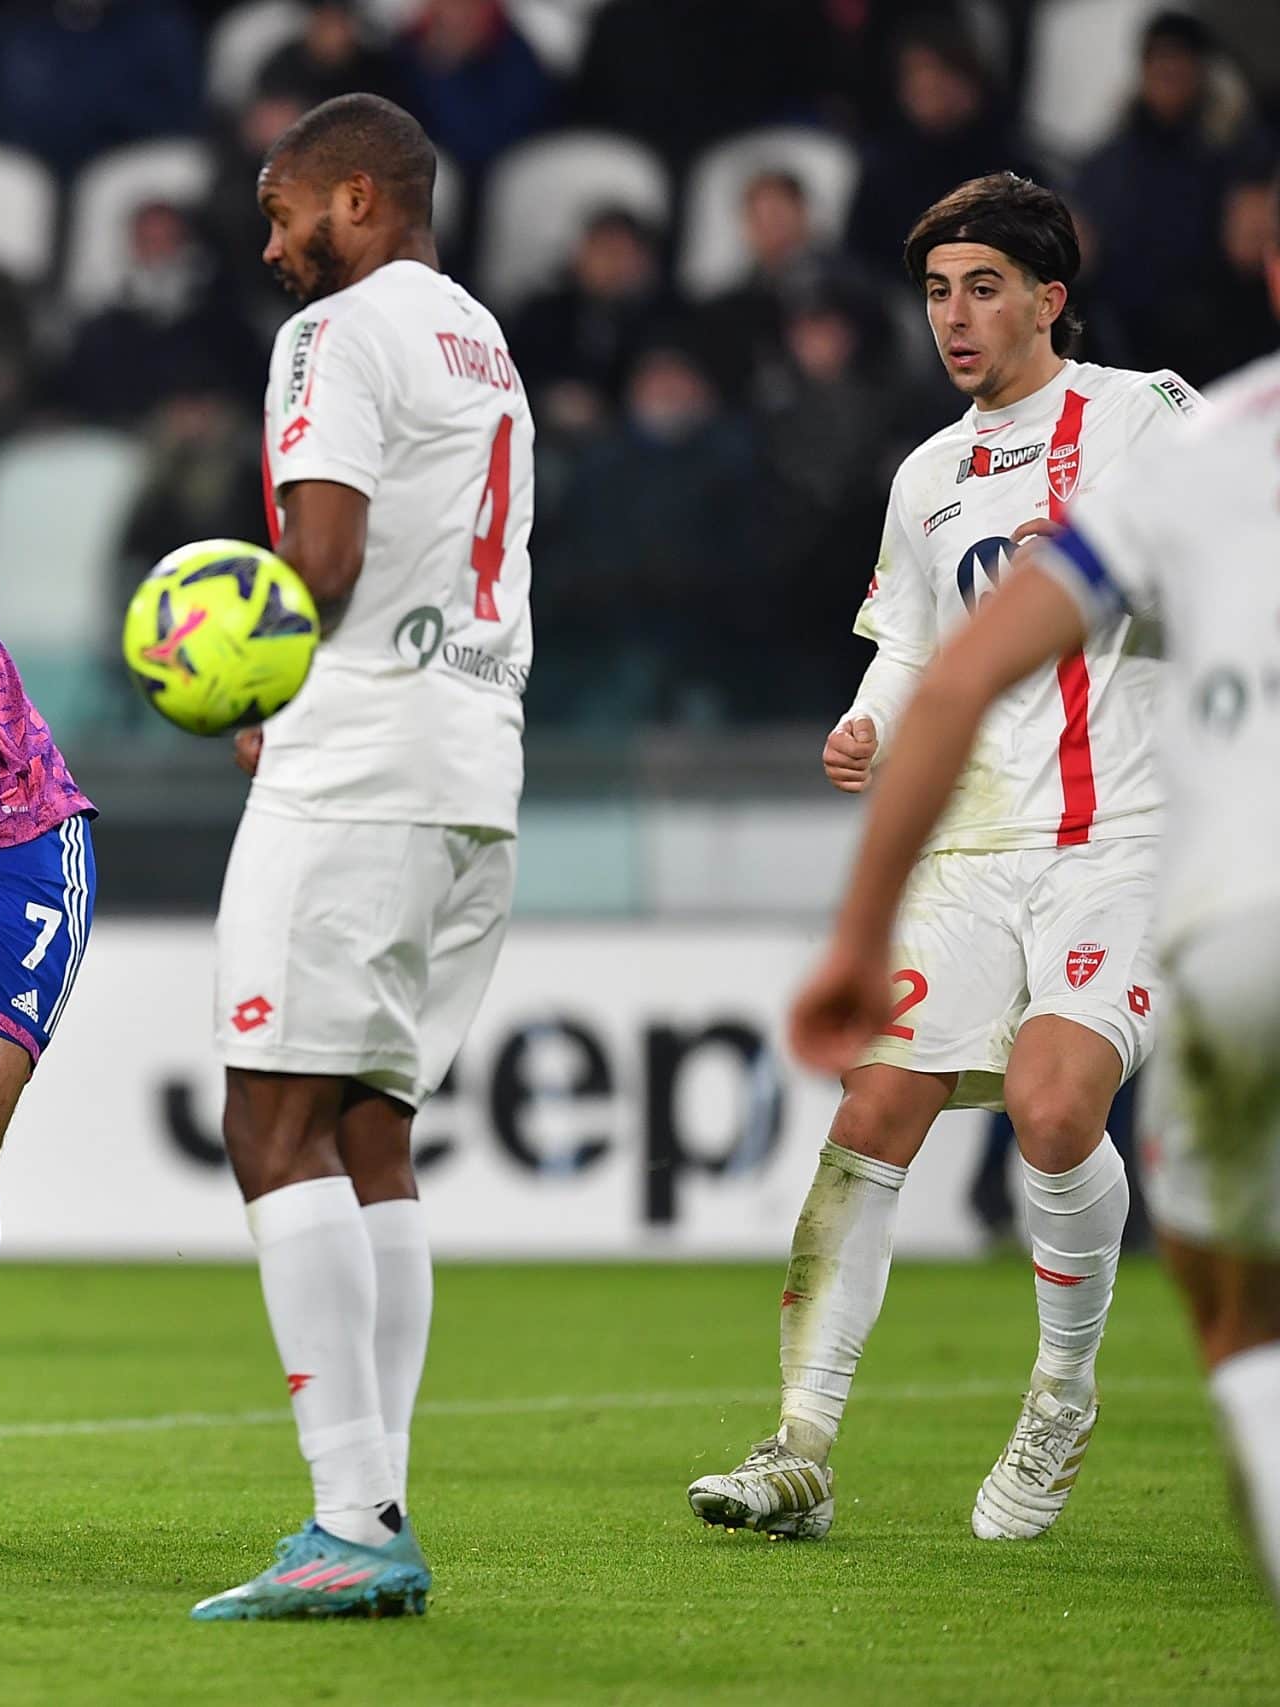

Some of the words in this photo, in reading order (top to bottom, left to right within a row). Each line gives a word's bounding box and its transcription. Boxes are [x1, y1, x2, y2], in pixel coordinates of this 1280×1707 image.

[1049, 460, 1078, 474] MONZA
[471, 413, 513, 622] 4
[21, 901, 63, 971] 7
[1068, 957, 1099, 966] MONZA
